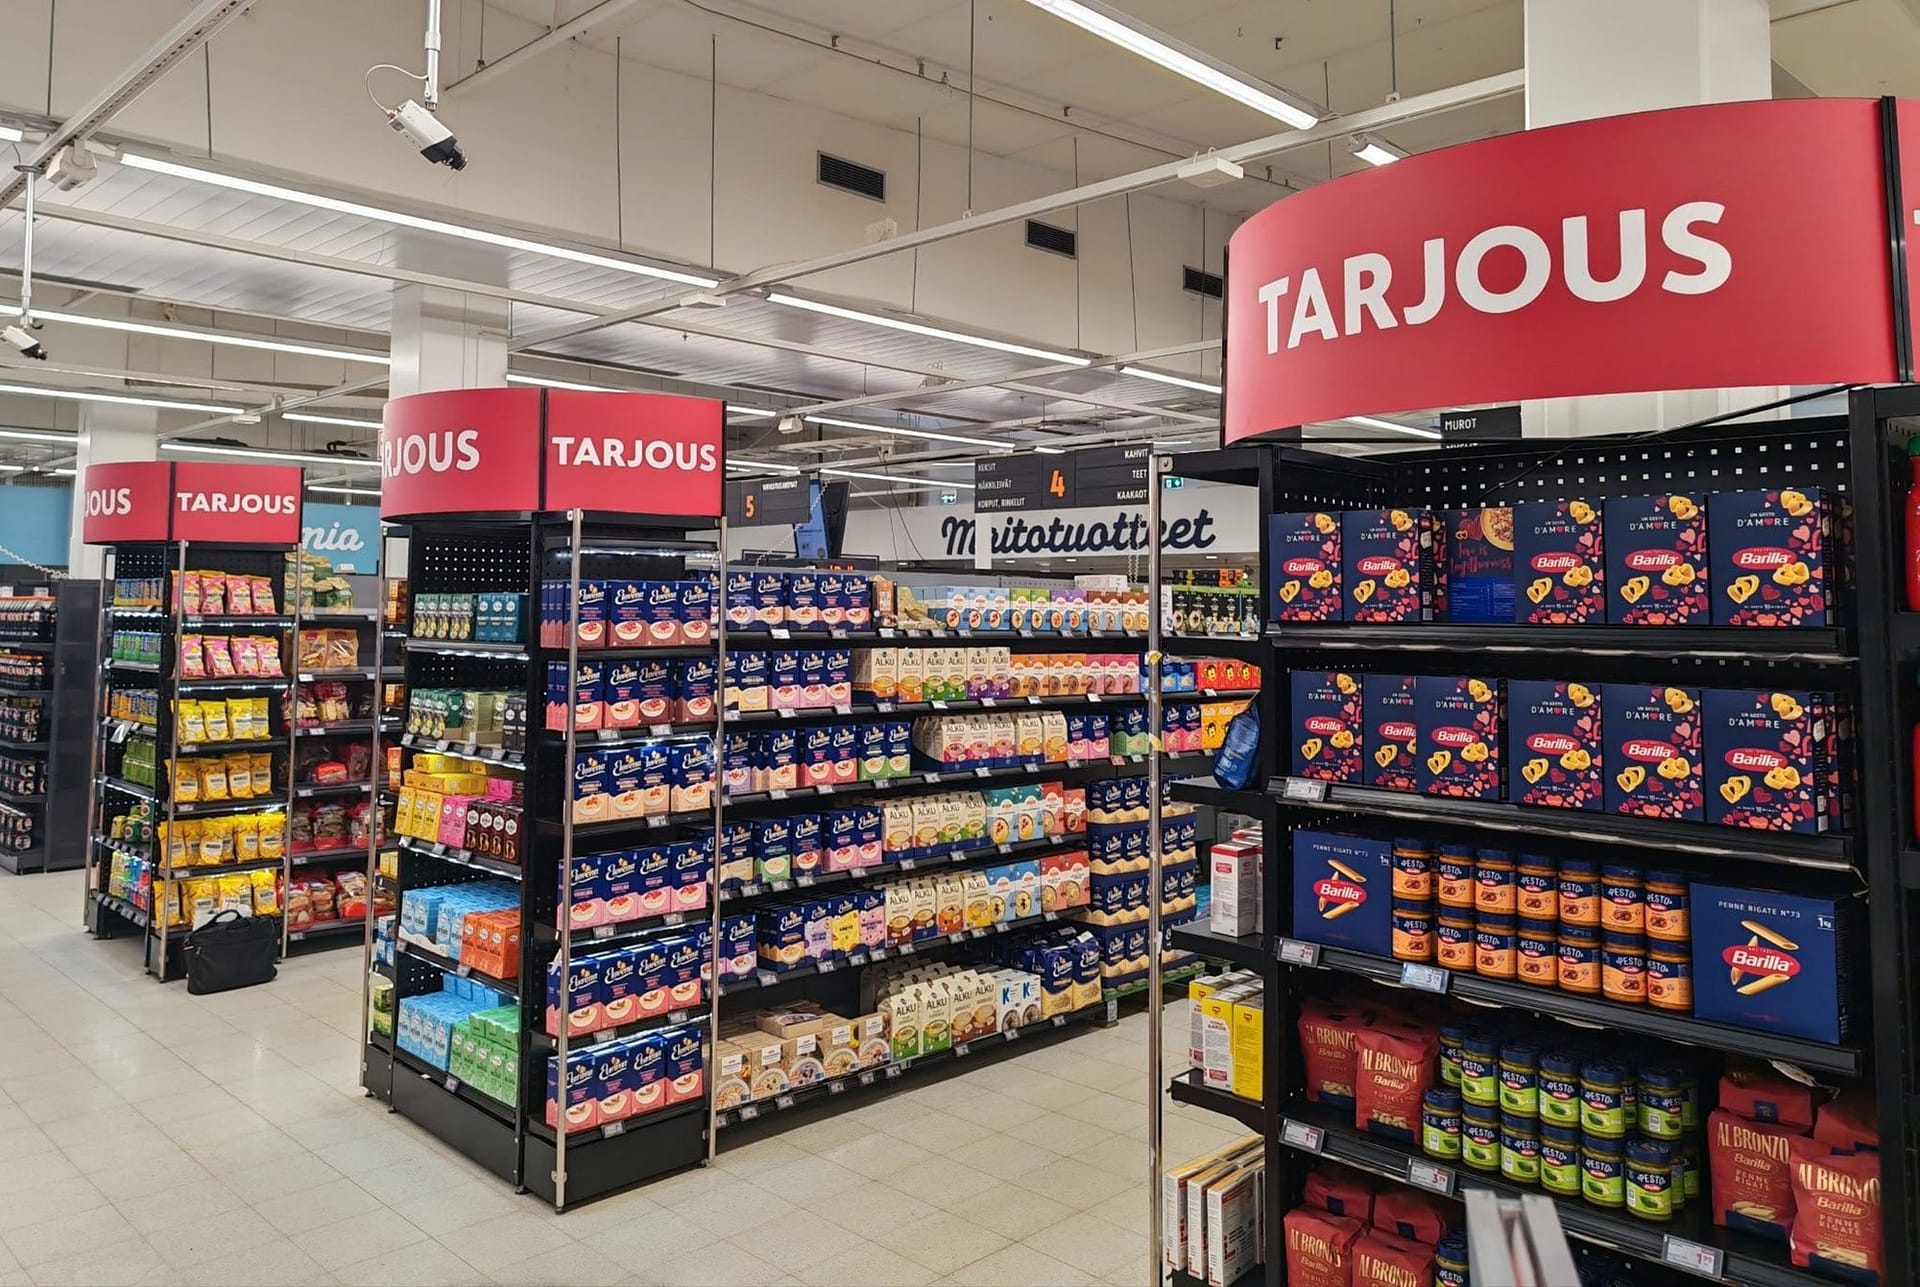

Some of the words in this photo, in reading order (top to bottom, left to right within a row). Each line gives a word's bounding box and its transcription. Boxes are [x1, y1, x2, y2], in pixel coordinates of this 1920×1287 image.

[1258, 201, 1732, 355] TARJOUS
[1444, 418, 1477, 431] MUROT
[552, 437, 717, 472] TARJOUS
[1125, 449, 1148, 459] KAHVIT
[1132, 469, 1148, 479] TEET
[1050, 469, 1065, 498] 4
[1117, 489, 1148, 500] KAAKAOT
[177, 492, 296, 514] TARJOUS
[745, 495, 755, 518] 5
[1537, 557, 1576, 568] Barilla
[1632, 555, 1678, 567] Barilla
[1740, 552, 1790, 565] Barilla
[1288, 561, 1320, 573] Barilla
[1362, 560, 1397, 571] Barilla
[1310, 719, 1341, 732] Barilla
[1437, 731, 1474, 743] Barilla
[1533, 738, 1573, 751] Barilla
[1628, 744, 1672, 758] Barilla
[1733, 752, 1780, 767] Barilla
[941, 883, 960, 895] ALKU
[967, 878, 986, 890] ALKU
[914, 888, 932, 899] ALKU
[1320, 883, 1360, 901] Barilla
[1608, 887, 1635, 898] PESTO
[889, 893, 909, 905] ALKU
[1718, 900, 1745, 911] PENNE
[1748, 905, 1777, 915] RIGATE
[1732, 950, 1789, 972] Barilla
[953, 990, 972, 1002] ALKU
[975, 983, 995, 996] ALKU
[1002, 987, 1010, 1004] K
[1023, 981, 1030, 998] K
[926, 996, 947, 1009] ALKU
[895, 1004, 917, 1016] ALKU
[1361, 1048, 1374, 1070] AL
[1373, 1074, 1404, 1090] Barilla
[1717, 1121, 1731, 1148] AL
[1734, 1126, 1790, 1161] BRONZO
[1734, 1152, 1771, 1171] Barilla
[1799, 1162, 1814, 1191] AL
[1817, 1196, 1865, 1215] Barilla
[1290, 1229, 1300, 1250] AL
[1359, 1254, 1370, 1276] AL
